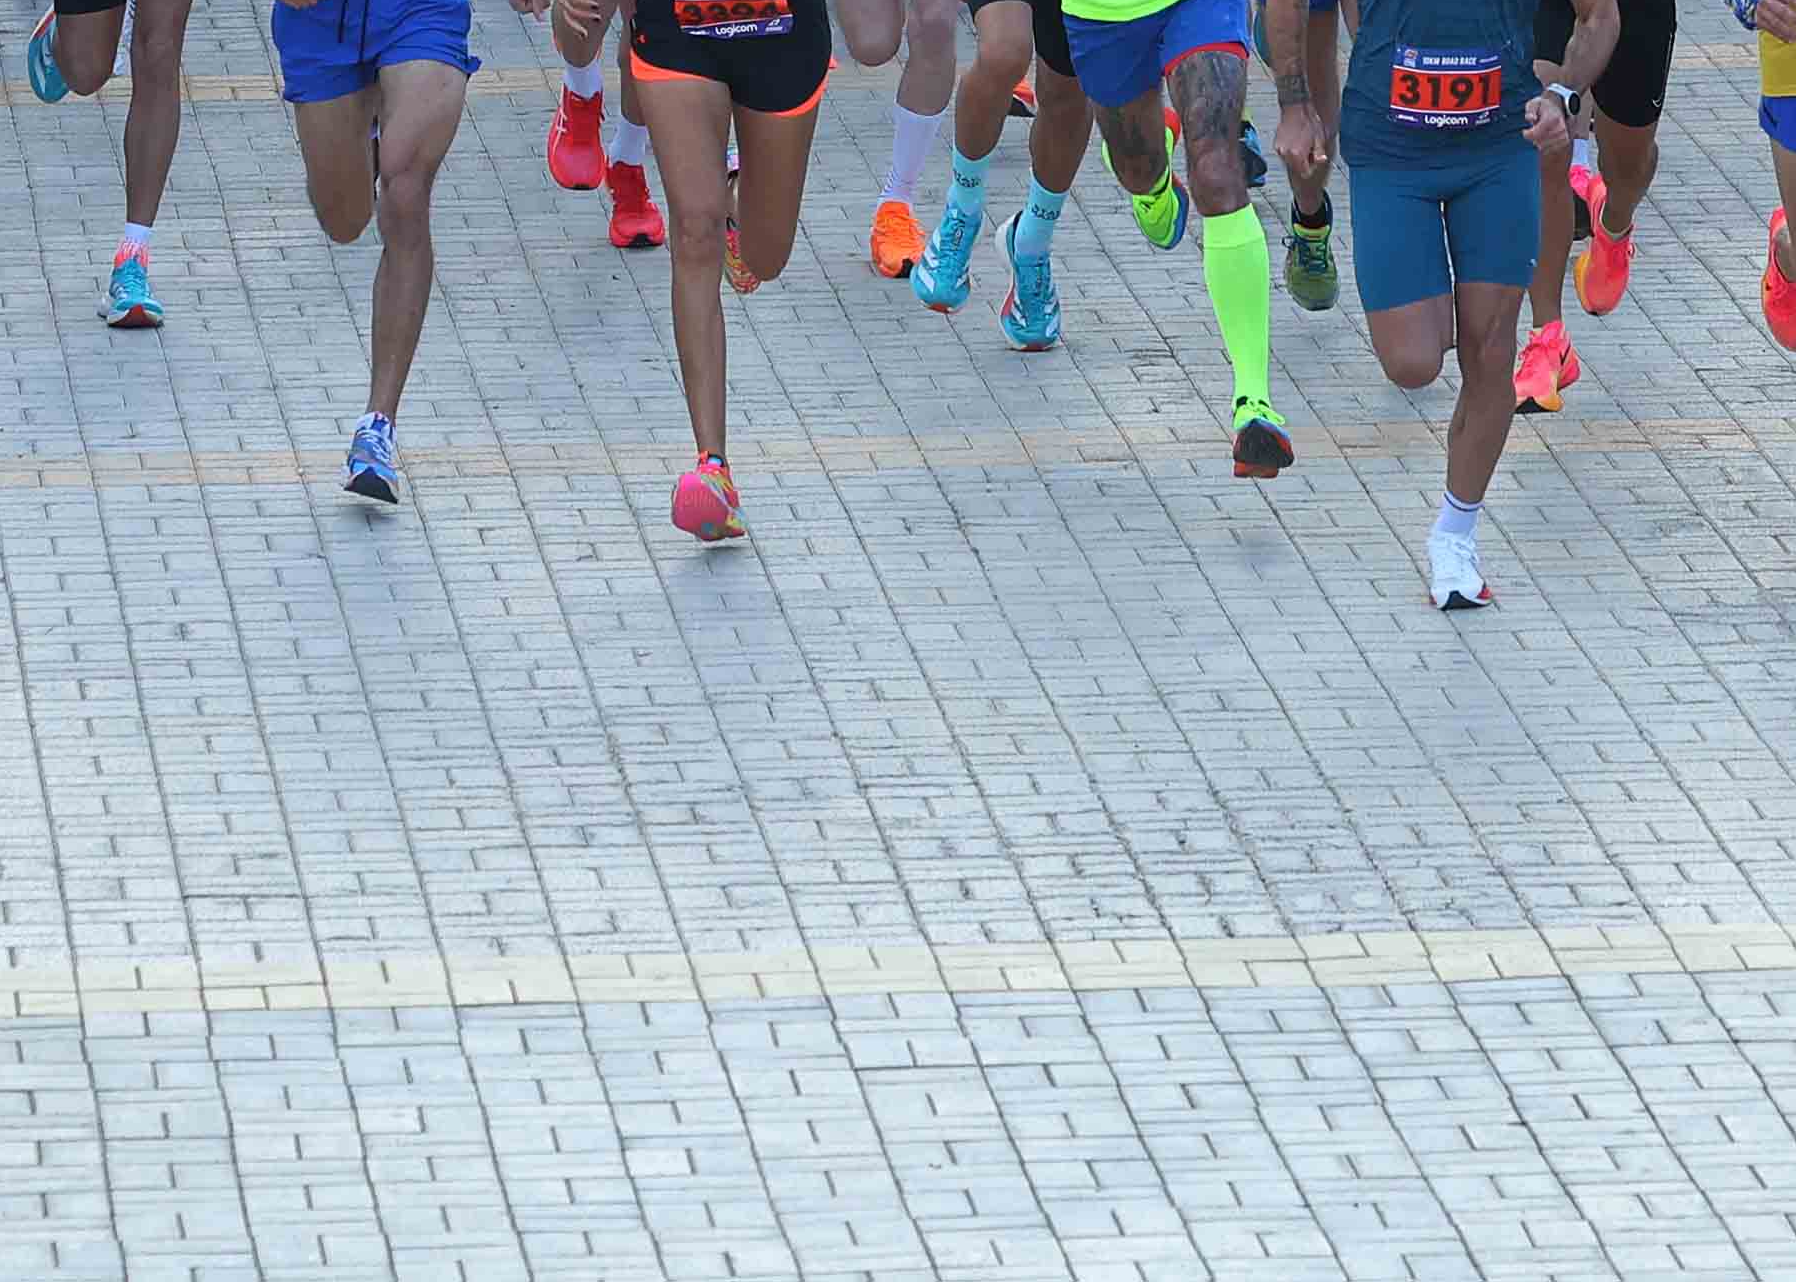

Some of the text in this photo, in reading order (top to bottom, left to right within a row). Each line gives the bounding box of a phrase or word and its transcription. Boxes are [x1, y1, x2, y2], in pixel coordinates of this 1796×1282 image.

[715, 22, 758, 37] Logicom
[1441, 56, 1458, 66] ROAD
[1459, 56, 1478, 66] RACE
[1398, 74, 1493, 107] 3191
[1424, 113, 1469, 127] Logicom
